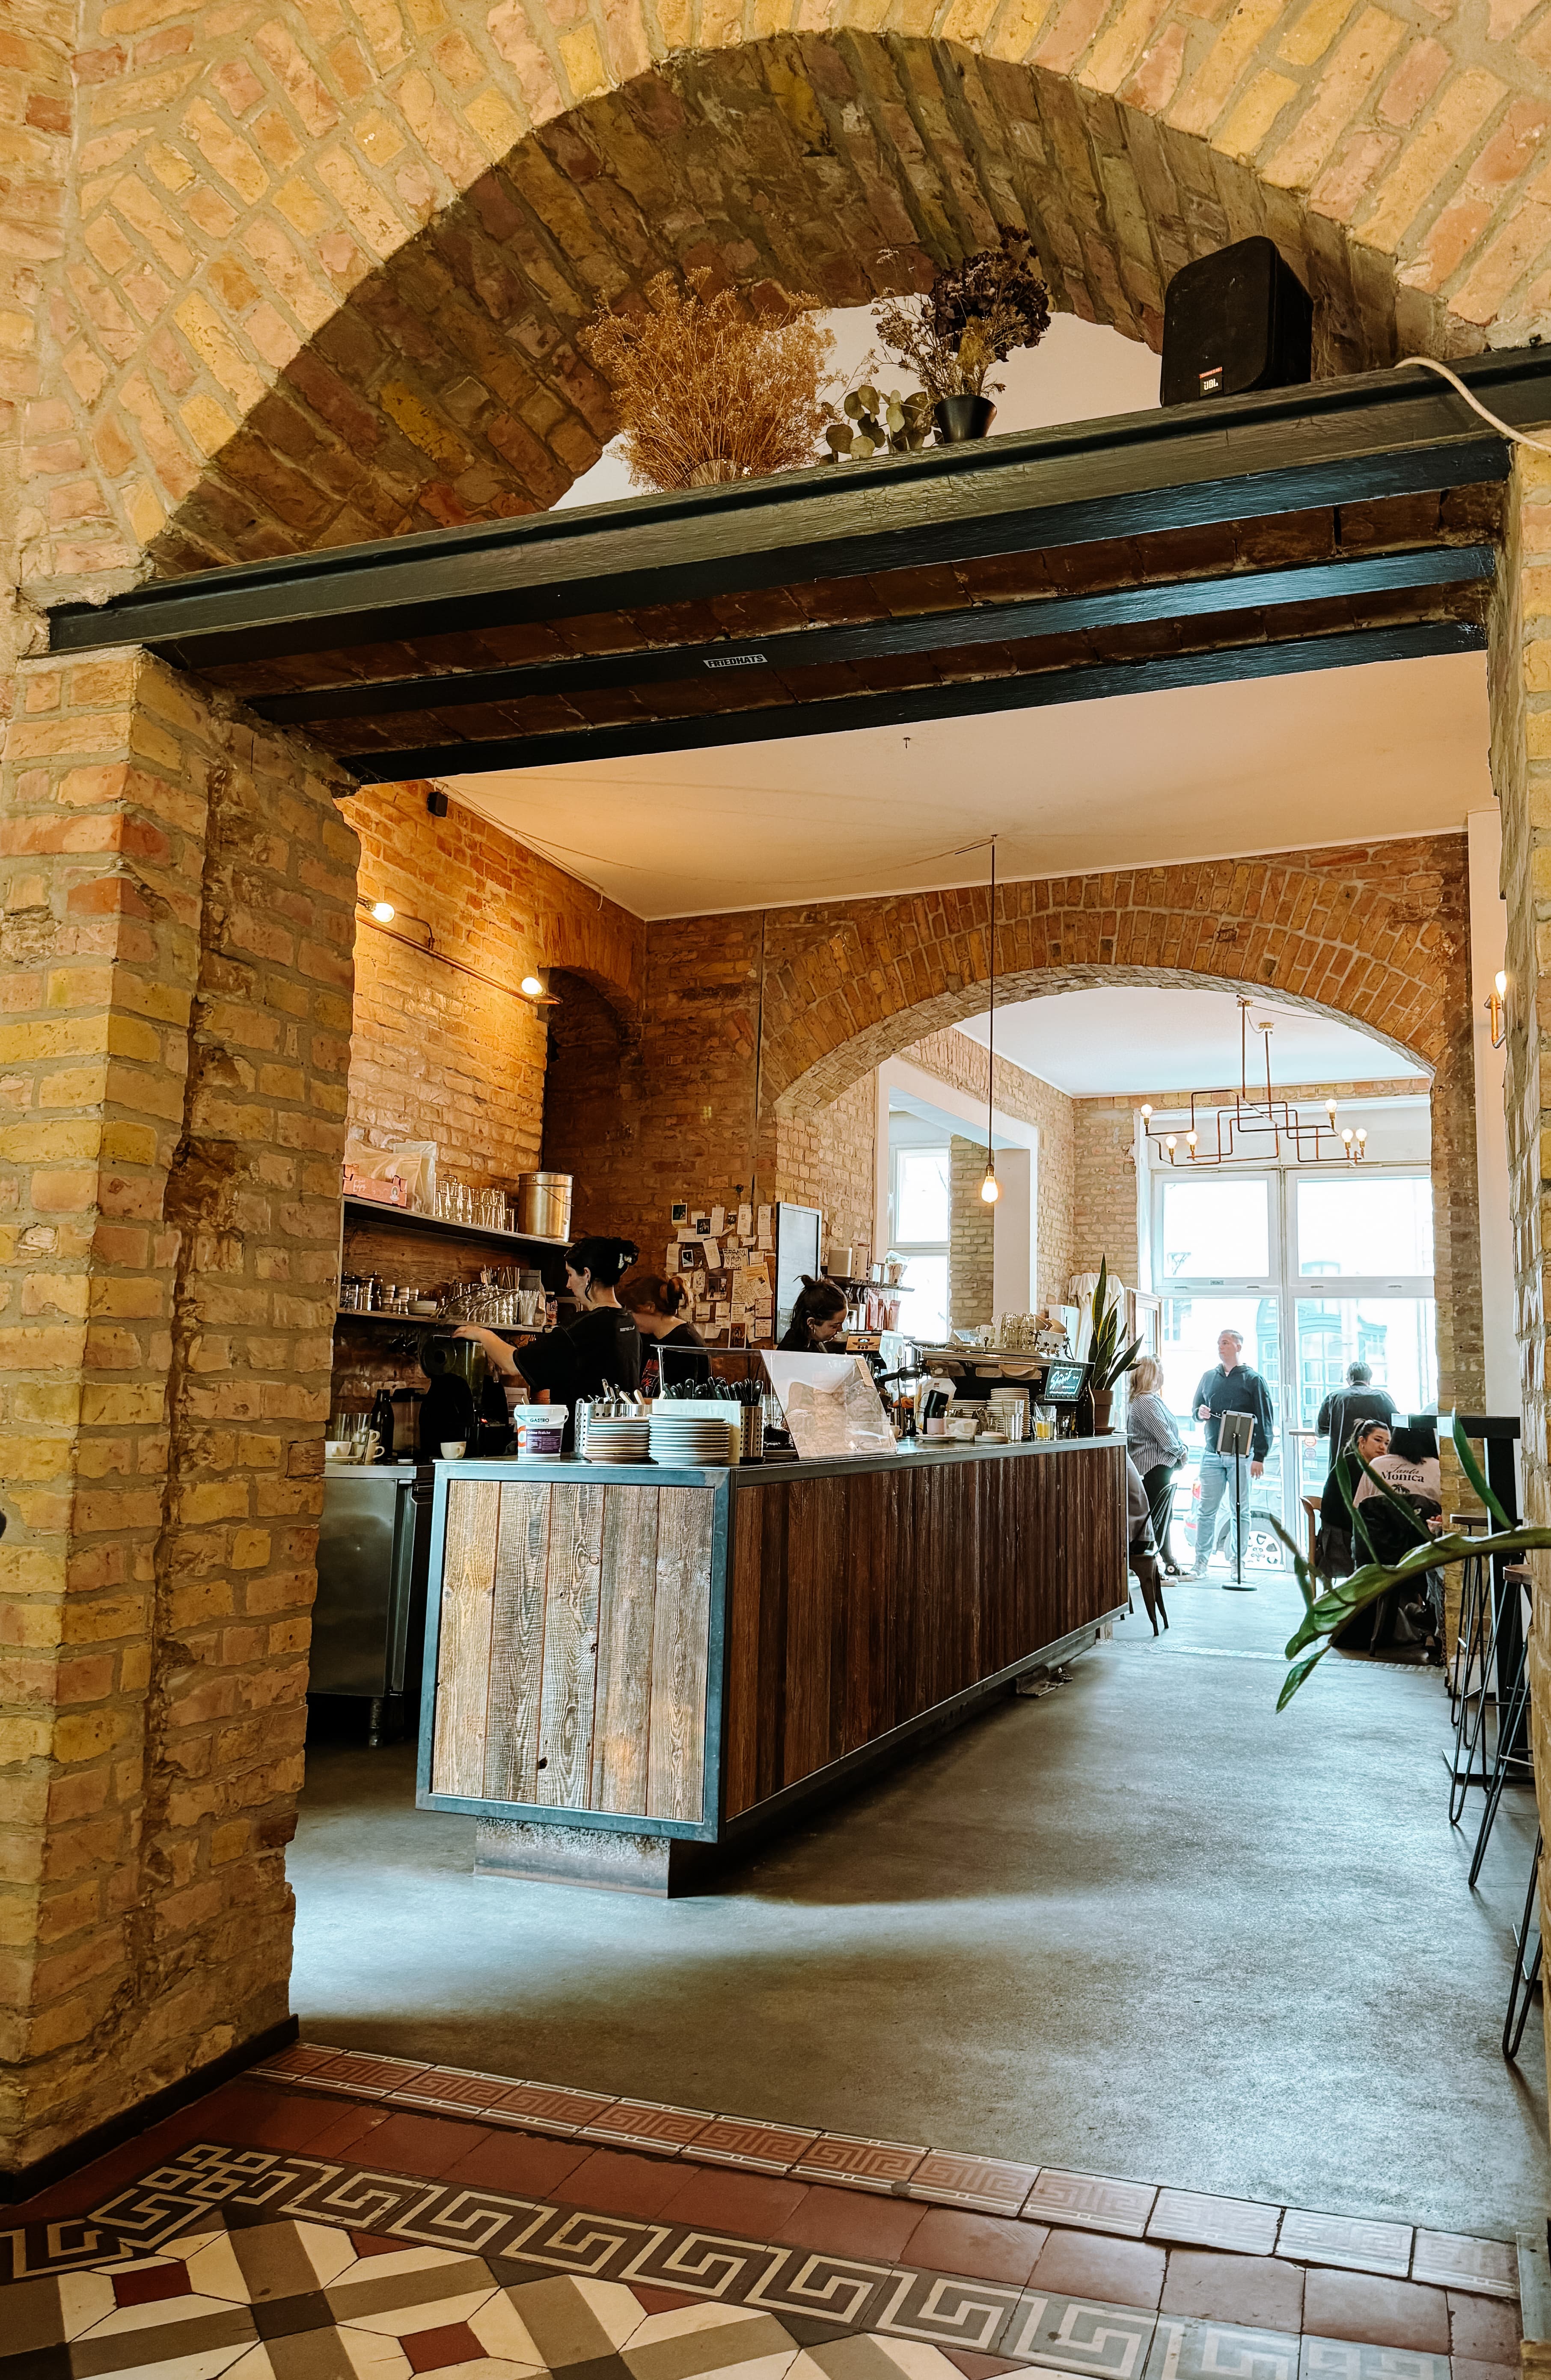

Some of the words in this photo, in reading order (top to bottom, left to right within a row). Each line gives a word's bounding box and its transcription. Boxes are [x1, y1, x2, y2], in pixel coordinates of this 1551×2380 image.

[1203, 378, 1218, 390] JBL
[707, 655, 764, 667] FRIEDHATS
[1390, 1463, 1420, 1474] Santa
[1382, 1471, 1424, 1483] Monica
